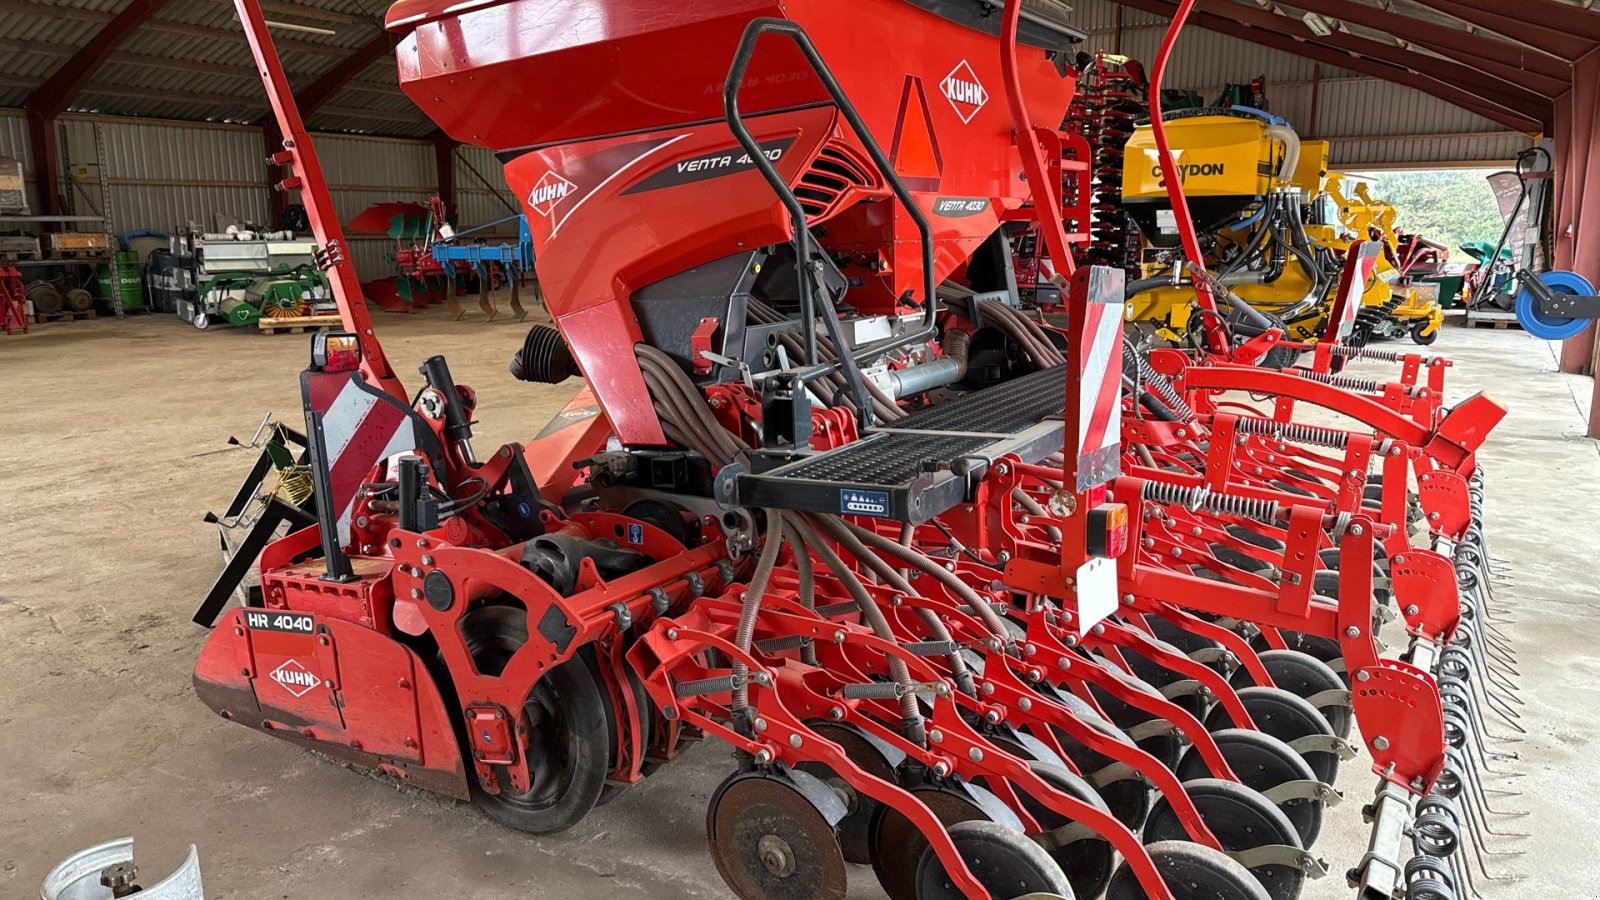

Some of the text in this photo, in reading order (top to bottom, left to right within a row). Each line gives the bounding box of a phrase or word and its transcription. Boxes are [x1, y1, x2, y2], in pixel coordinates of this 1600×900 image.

[947, 77, 982, 106] KUHN
[677, 156, 732, 173] VENTA
[1151, 164, 1224, 184] CYDON
[532, 182, 568, 207] KUHN
[939, 200, 986, 211] VENTA 4030
[248, 613, 313, 631] HR 4040
[276, 669, 314, 687] KUHN
